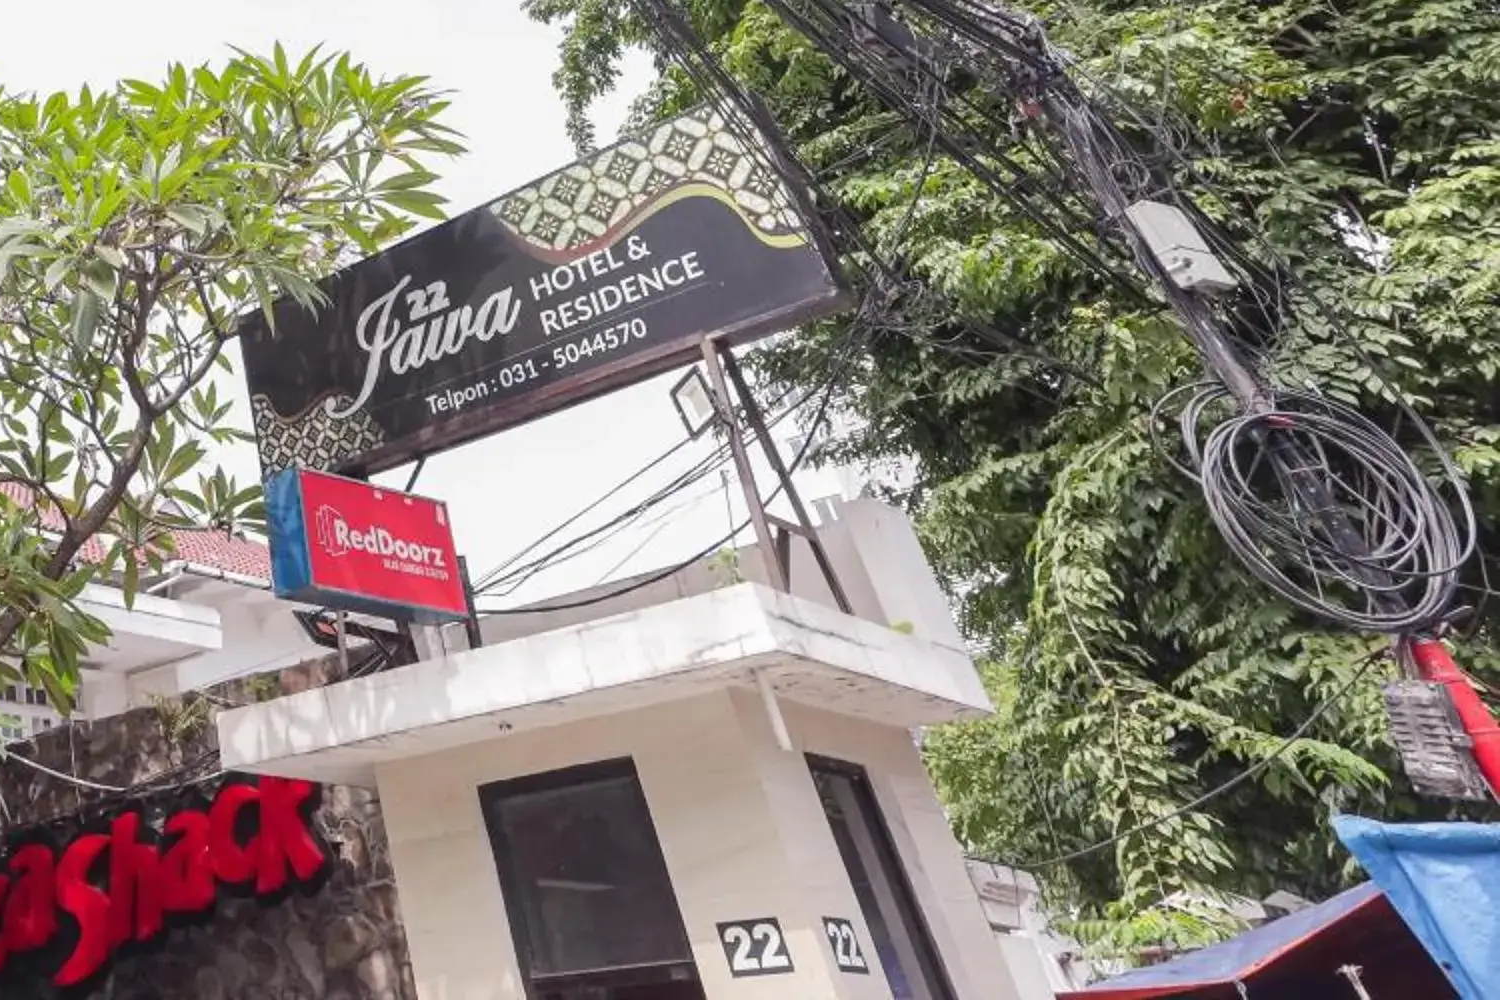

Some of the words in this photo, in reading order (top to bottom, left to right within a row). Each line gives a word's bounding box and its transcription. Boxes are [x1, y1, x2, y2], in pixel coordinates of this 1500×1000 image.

[529, 247, 624, 301] HOTEL
[627, 235, 651, 261] &
[539, 251, 705, 337] RESIDENCE
[405, 280, 451, 321] 22
[324, 274, 521, 419] Jawa
[425, 379, 489, 415] Telpon
[499, 358, 539, 388] 031
[553, 317, 648, 369] 5044570
[333, 519, 446, 567] RedDoorz
[723, 923, 789, 971] 22
[827, 921, 865, 967] 22
